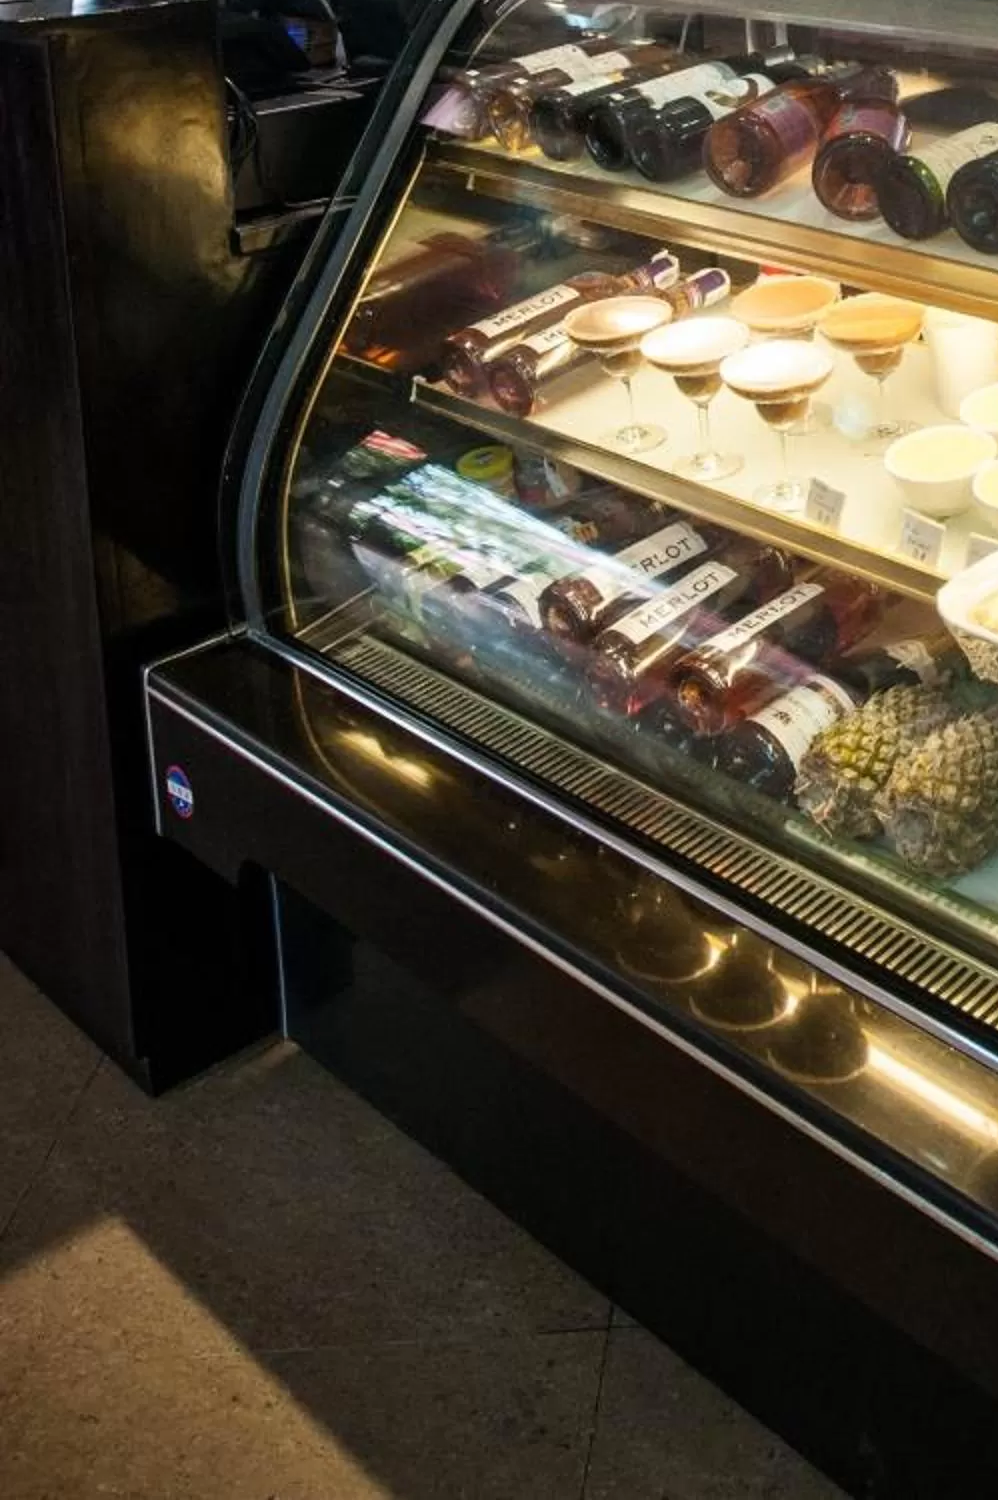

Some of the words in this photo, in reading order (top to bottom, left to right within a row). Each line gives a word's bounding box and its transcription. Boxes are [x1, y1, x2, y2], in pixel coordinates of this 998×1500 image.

[493, 291, 564, 326] MERLOT
[628, 536, 690, 575] RLOT
[639, 571, 721, 629] MERLOT
[729, 588, 808, 640] MERLOT
